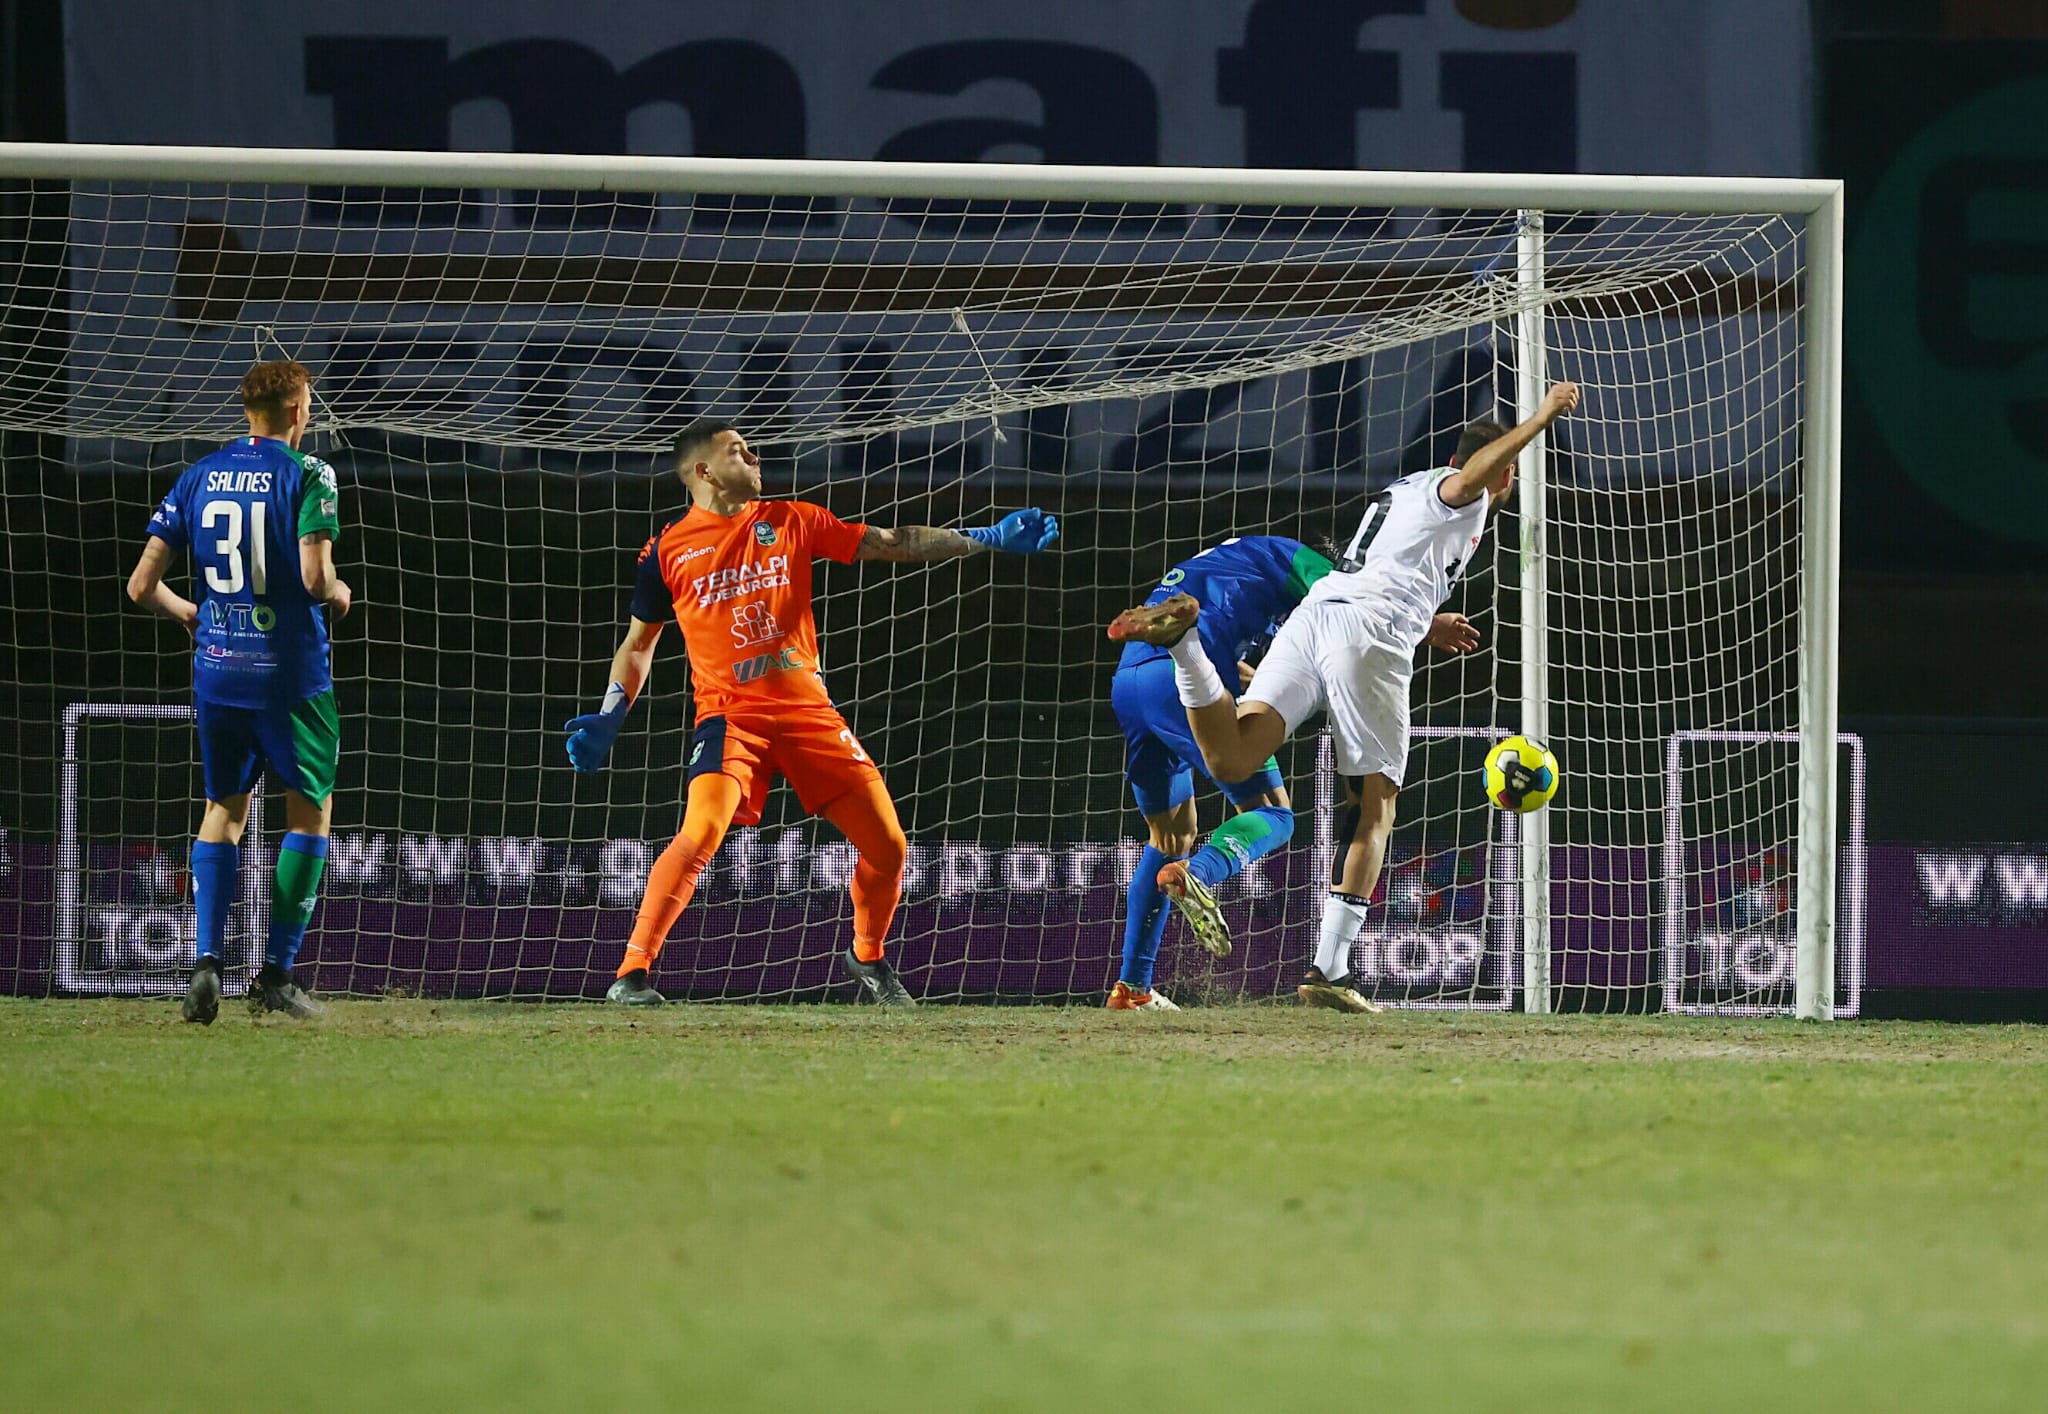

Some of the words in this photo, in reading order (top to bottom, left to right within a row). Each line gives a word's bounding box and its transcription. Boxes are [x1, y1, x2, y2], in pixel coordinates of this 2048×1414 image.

[304, 0, 1592, 236] mafi
[207, 470, 272, 493] SALINES
[201, 500, 266, 595] 31
[693, 553, 788, 595] FERALPI
[698, 574, 790, 608] SIDERURGICA
[1356, 930, 1480, 981] TOP
